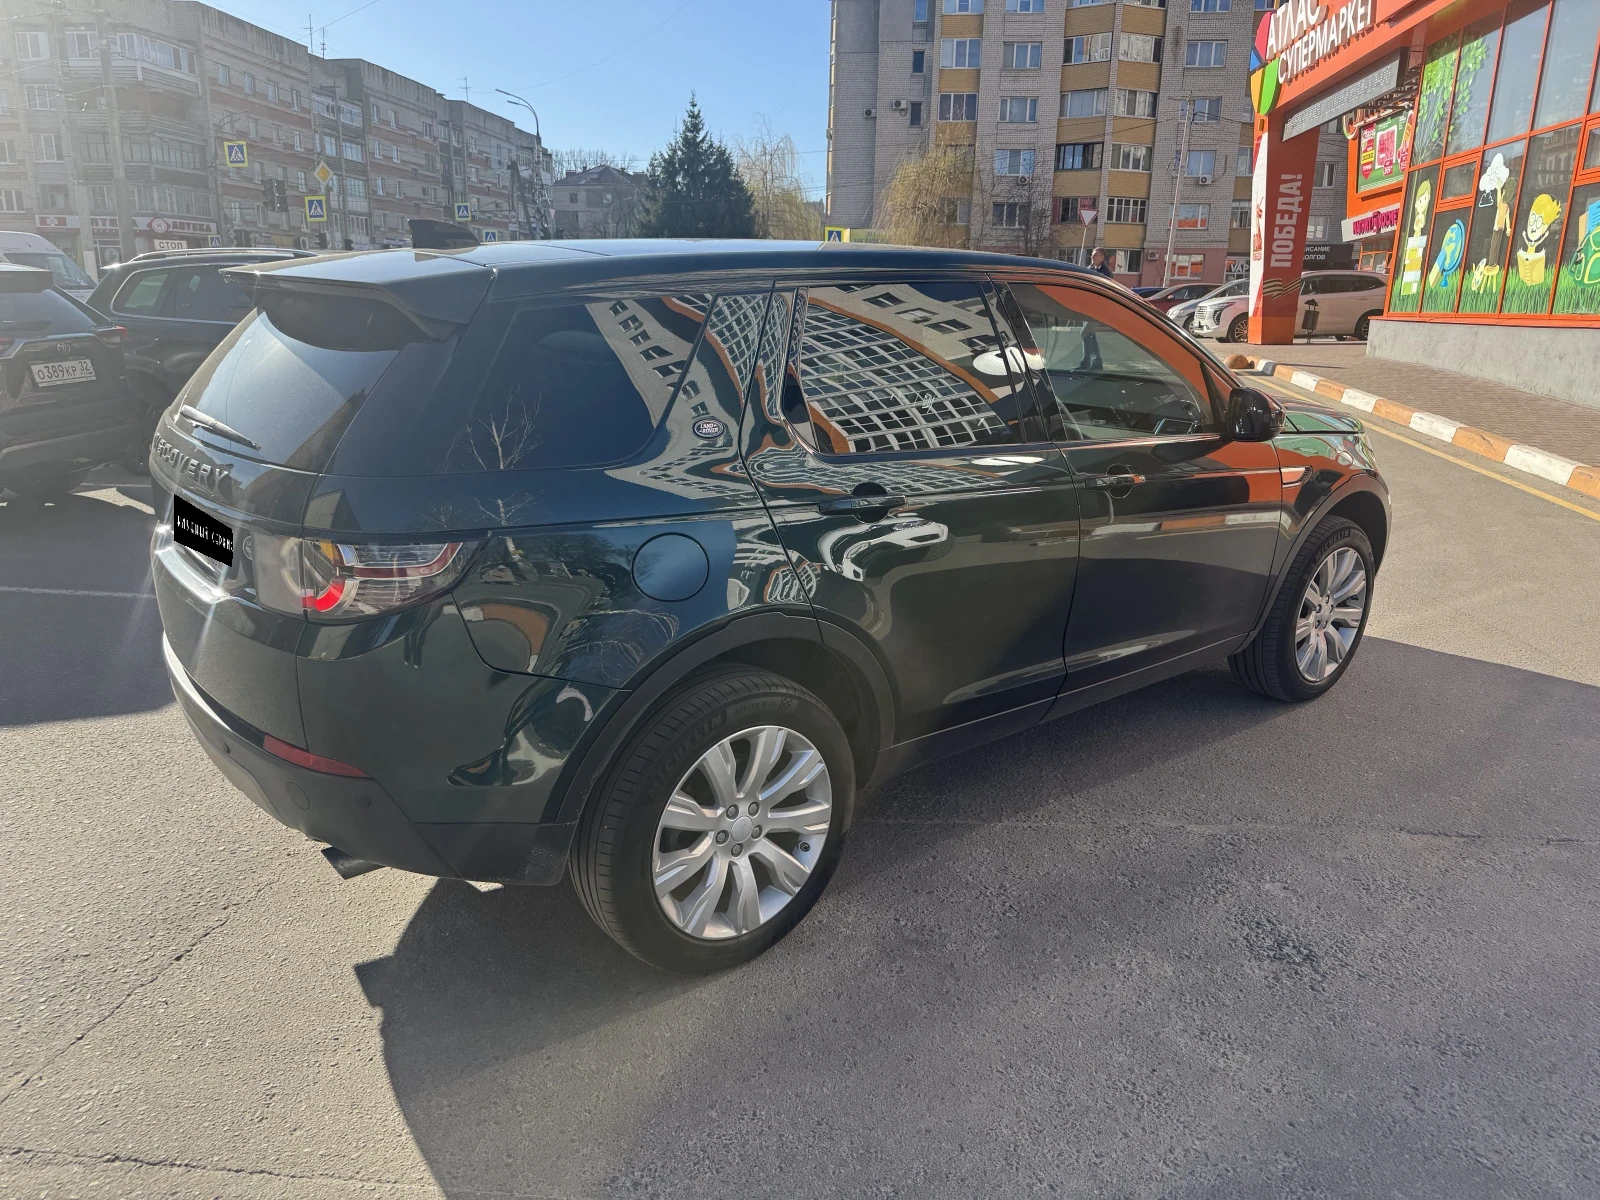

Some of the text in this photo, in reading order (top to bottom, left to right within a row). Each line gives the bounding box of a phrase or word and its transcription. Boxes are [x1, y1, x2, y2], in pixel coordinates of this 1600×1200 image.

[1266, 0, 1321, 59] АТЛАС
[1278, 0, 1372, 84] СУПЕРМАРКЕТ
[171, 220, 212, 233] АПТЕКА
[1270, 174, 1303, 267] ПОБЕДА!
[158, 241, 183, 250] СТОП
[78, 361, 89, 371] 32
